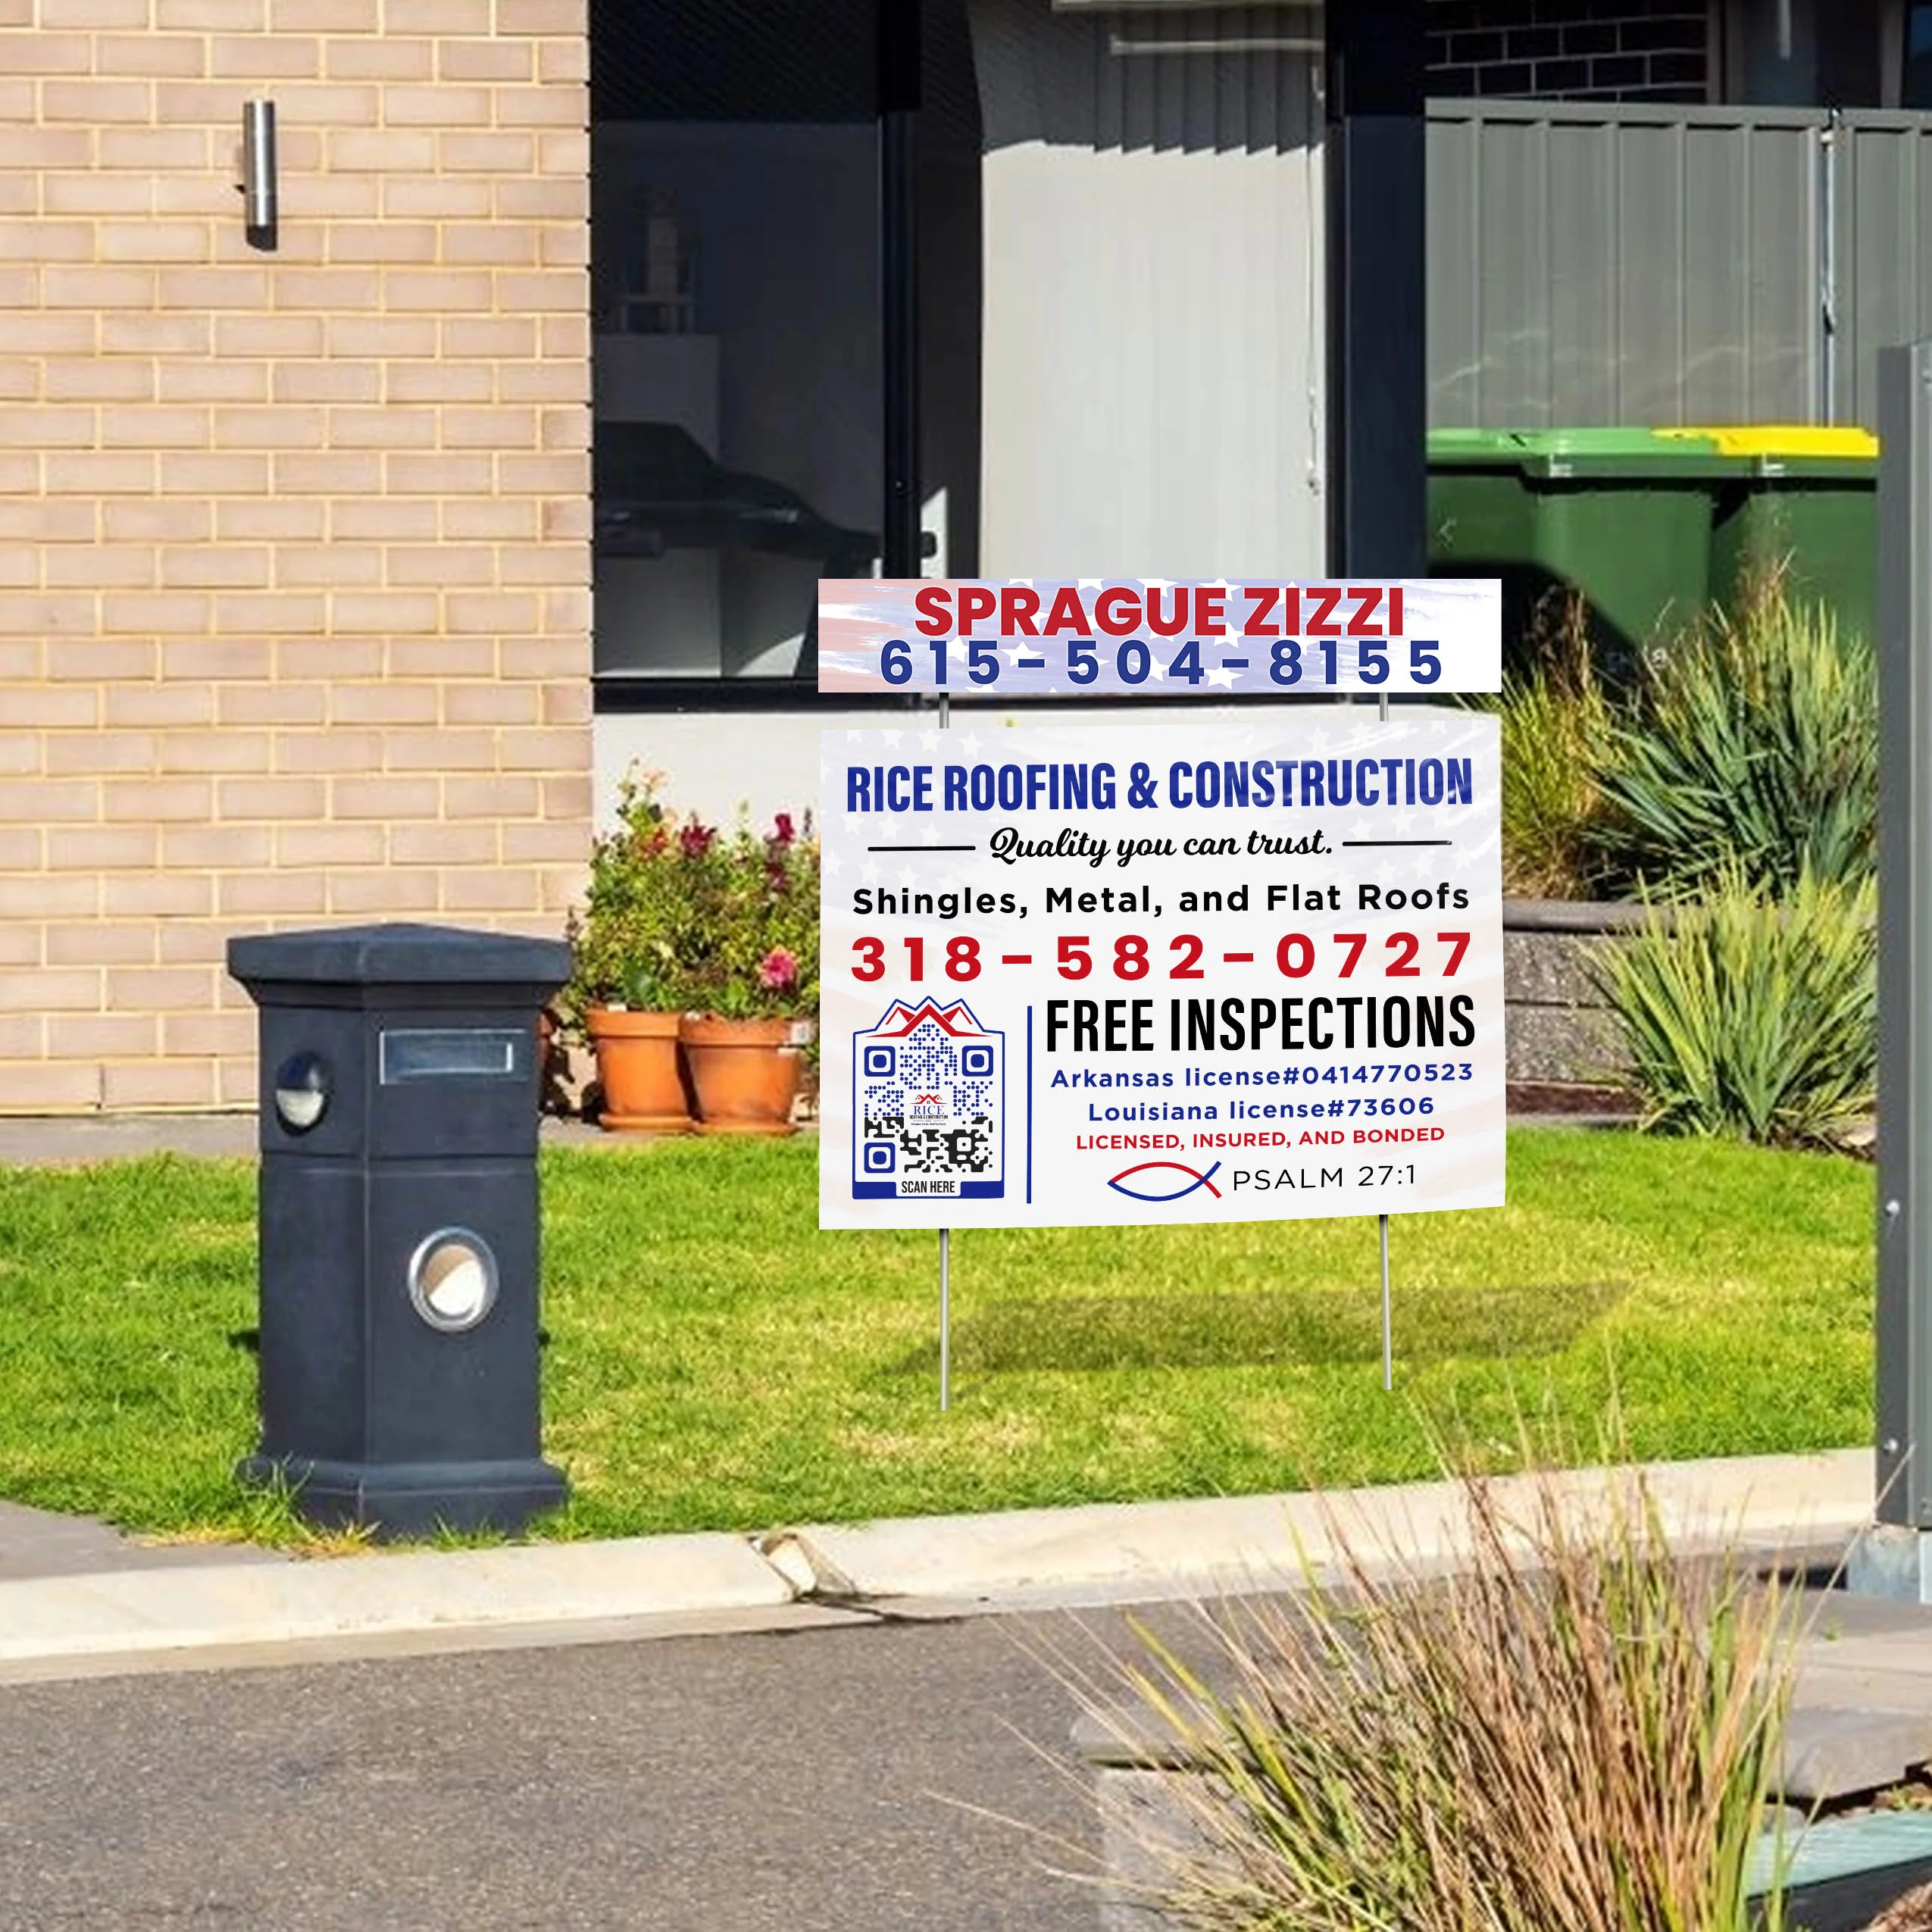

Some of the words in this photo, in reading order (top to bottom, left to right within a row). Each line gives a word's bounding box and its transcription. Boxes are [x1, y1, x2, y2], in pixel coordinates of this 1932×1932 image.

[914, 586, 1226, 637] SPRAGUE
[1245, 588, 1404, 636] ZIZZI
[847, 765, 933, 812] RICE
[944, 762, 1116, 811] ROOFING
[1127, 762, 1158, 809] &
[1169, 758, 1473, 808] CONSTRUCTION
[989, 827, 1111, 868] Quality
[1117, 838, 1177, 868] you
[1183, 837, 1241, 856] can
[1247, 828, 1333, 855] trust.
[852, 886, 1027, 920] Shingles,
[1046, 885, 1164, 918] Metal,
[1179, 884, 1249, 912] and
[1268, 883, 1340, 911] Flat
[1358, 882, 1469, 910] Roofs
[1047, 999, 1154, 1052] FREE
[1171, 994, 1476, 1051] INSPECTIONS
[1051, 1069, 1174, 1088] Arkansas
[1186, 1063, 1473, 1086] license#0414770523
[914, 1105, 945, 1115] RICE
[1089, 1102, 1218, 1121] Louisiana
[1230, 1096, 1434, 1119] license#73606
[1077, 1134, 1185, 1151] LICENSED,
[1193, 1132, 1292, 1149] INSURED,
[1299, 1130, 1345, 1145] AND
[1353, 1127, 1445, 1143] BONDED
[902, 1180, 927, 1193] SCAN
[930, 1180, 955, 1193] HERE
[1233, 1168, 1343, 1192] PSALM
[1358, 1164, 1415, 1186] 27:1
